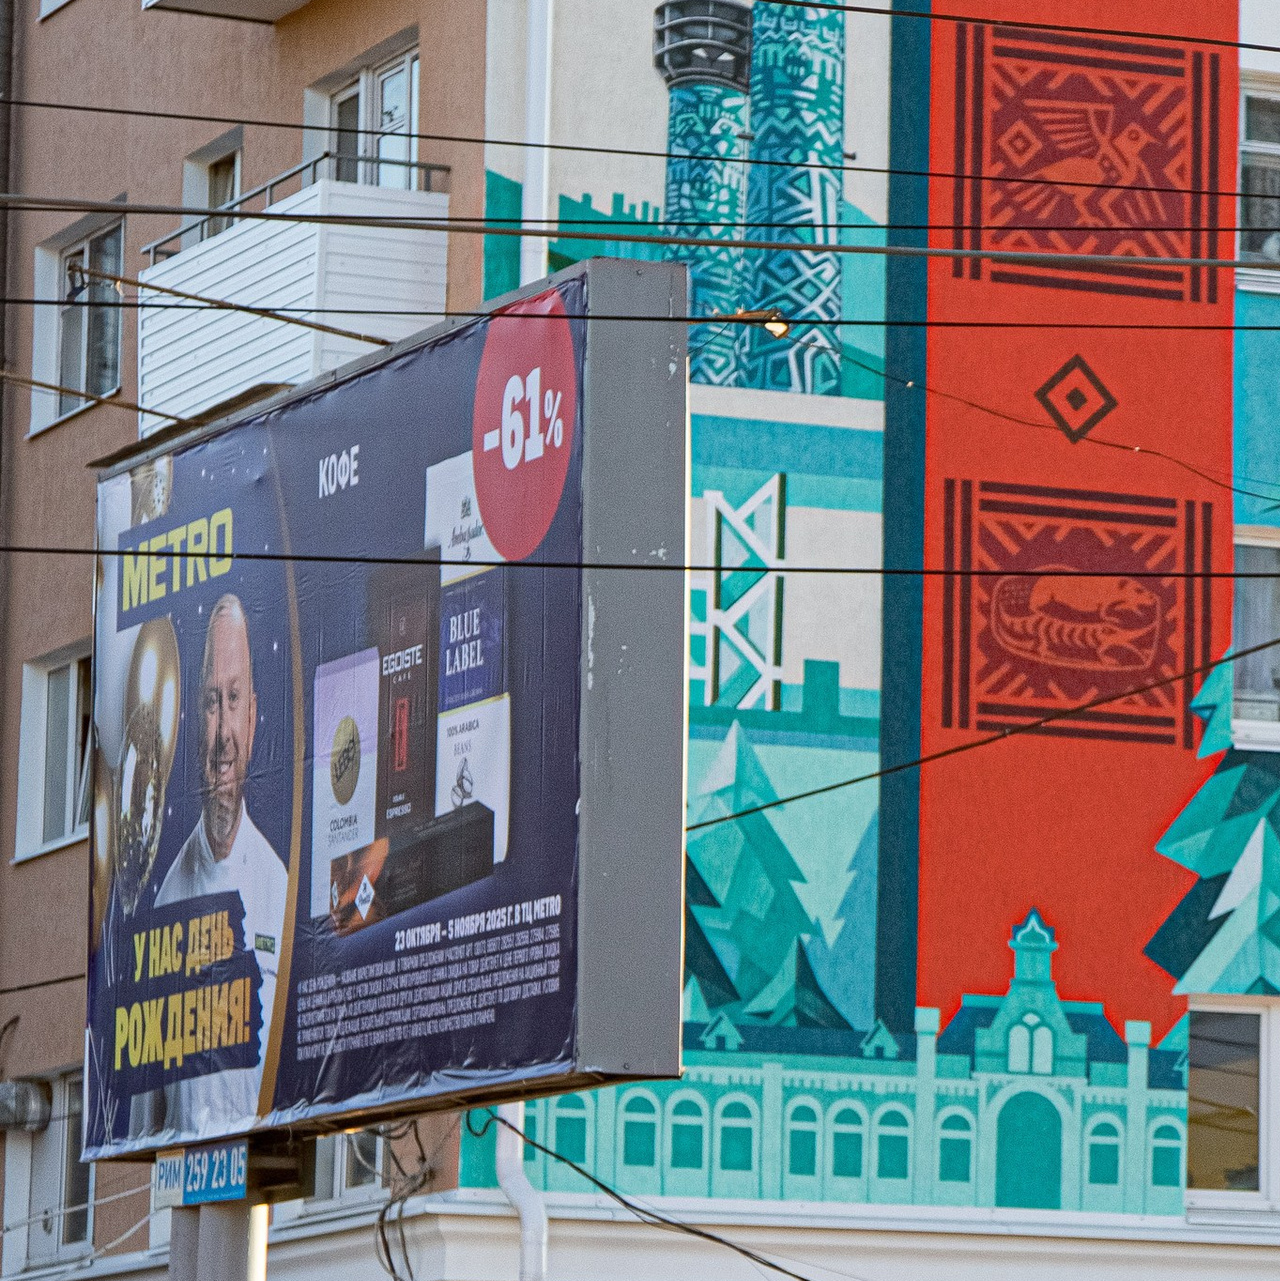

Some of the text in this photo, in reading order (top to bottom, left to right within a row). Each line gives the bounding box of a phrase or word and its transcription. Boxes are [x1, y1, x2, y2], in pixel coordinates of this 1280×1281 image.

[484, 367, 563, 470] -61%
[318, 444, 359, 499] КОФЕ
[122, 508, 233, 612] METRO
[449, 608, 481, 644] BLUE
[382, 644, 424, 676] EGOISTE
[445, 639, 484, 677] LABEL
[134, 910, 235, 982] У НАС ДЕНЬ
[395, 930, 405, 951] 23
[406, 922, 442, 948] ОКТЯБРЯ
[455, 912, 486, 939] НОЯБРЯ
[486, 905, 507, 932] 2025
[514, 901, 521, 924] В
[533, 894, 562, 921] METRO
[114, 976, 251, 1071] РОЖДЕНИЯ!
[158, 1158, 181, 1191] РИМ
[187, 1145, 247, 1193] 259 23 05
